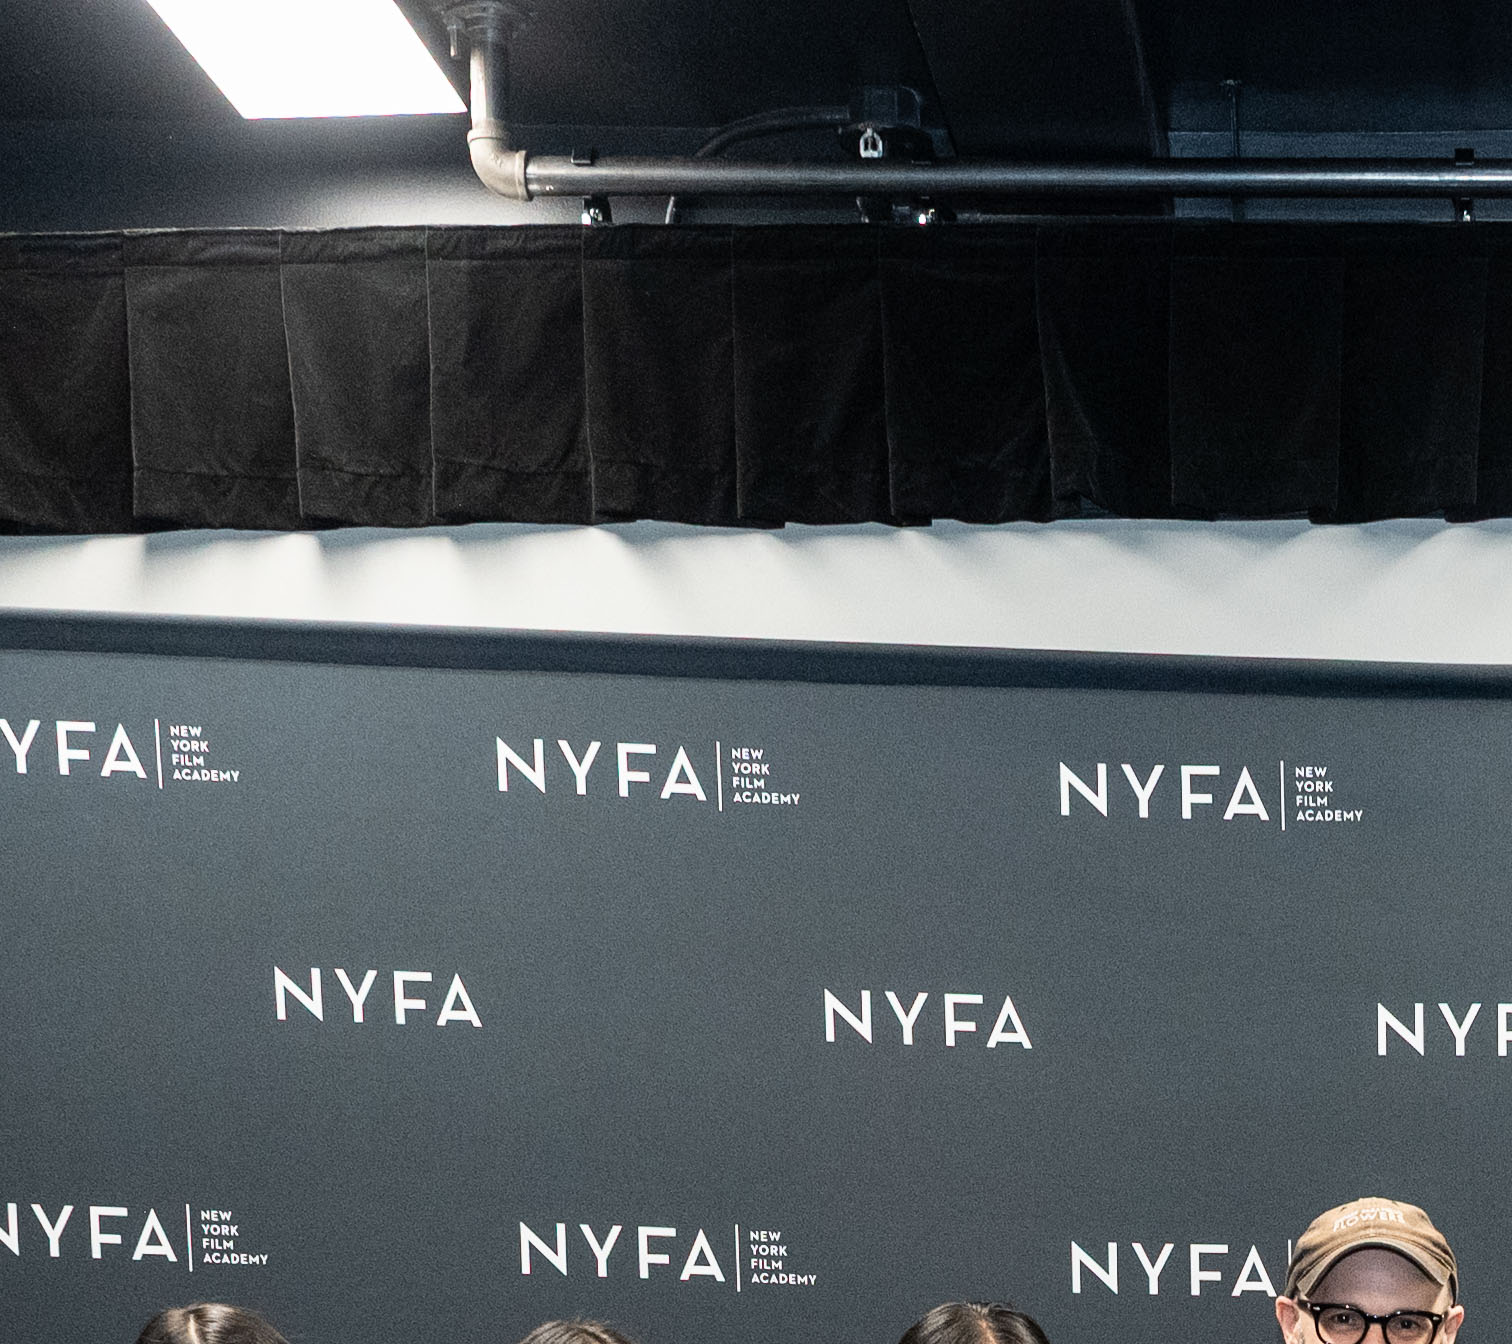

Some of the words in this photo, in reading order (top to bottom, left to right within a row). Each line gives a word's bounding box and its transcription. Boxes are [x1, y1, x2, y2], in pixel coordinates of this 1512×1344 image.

[169, 725, 202, 738] NEW
[170, 739, 209, 753] YORK
[171, 753, 205, 767] FILM
[731, 748, 764, 760] NEW
[173, 768, 240, 782] ACADEMY
[496, 736, 707, 801] NYFA
[732, 762, 770, 775] YORK
[1295, 766, 1327, 778] NEW
[732, 776, 765, 789] FILM
[1295, 780, 1333, 793] YORK
[1059, 761, 1270, 821] NYFA
[733, 791, 800, 805] ACADEMY
[1296, 795, 1328, 807] FILM
[1296, 809, 1363, 822] ACADEMY
[274, 966, 483, 1028] NYFA
[824, 988, 1033, 1049] NYFA
[200, 1210, 232, 1222] NEW
[201, 1224, 239, 1236] YORK
[749, 1230, 781, 1242] NEW
[202, 1237, 234, 1250] FILM
[519, 1221, 726, 1282] NYFA
[750, 1244, 788, 1257] YORK
[203, 1252, 268, 1265] ACADEMY
[750, 1258, 783, 1270] FILM
[1071, 1241, 1277, 1298] NYFA
[751, 1272, 817, 1285] ACADEMY
